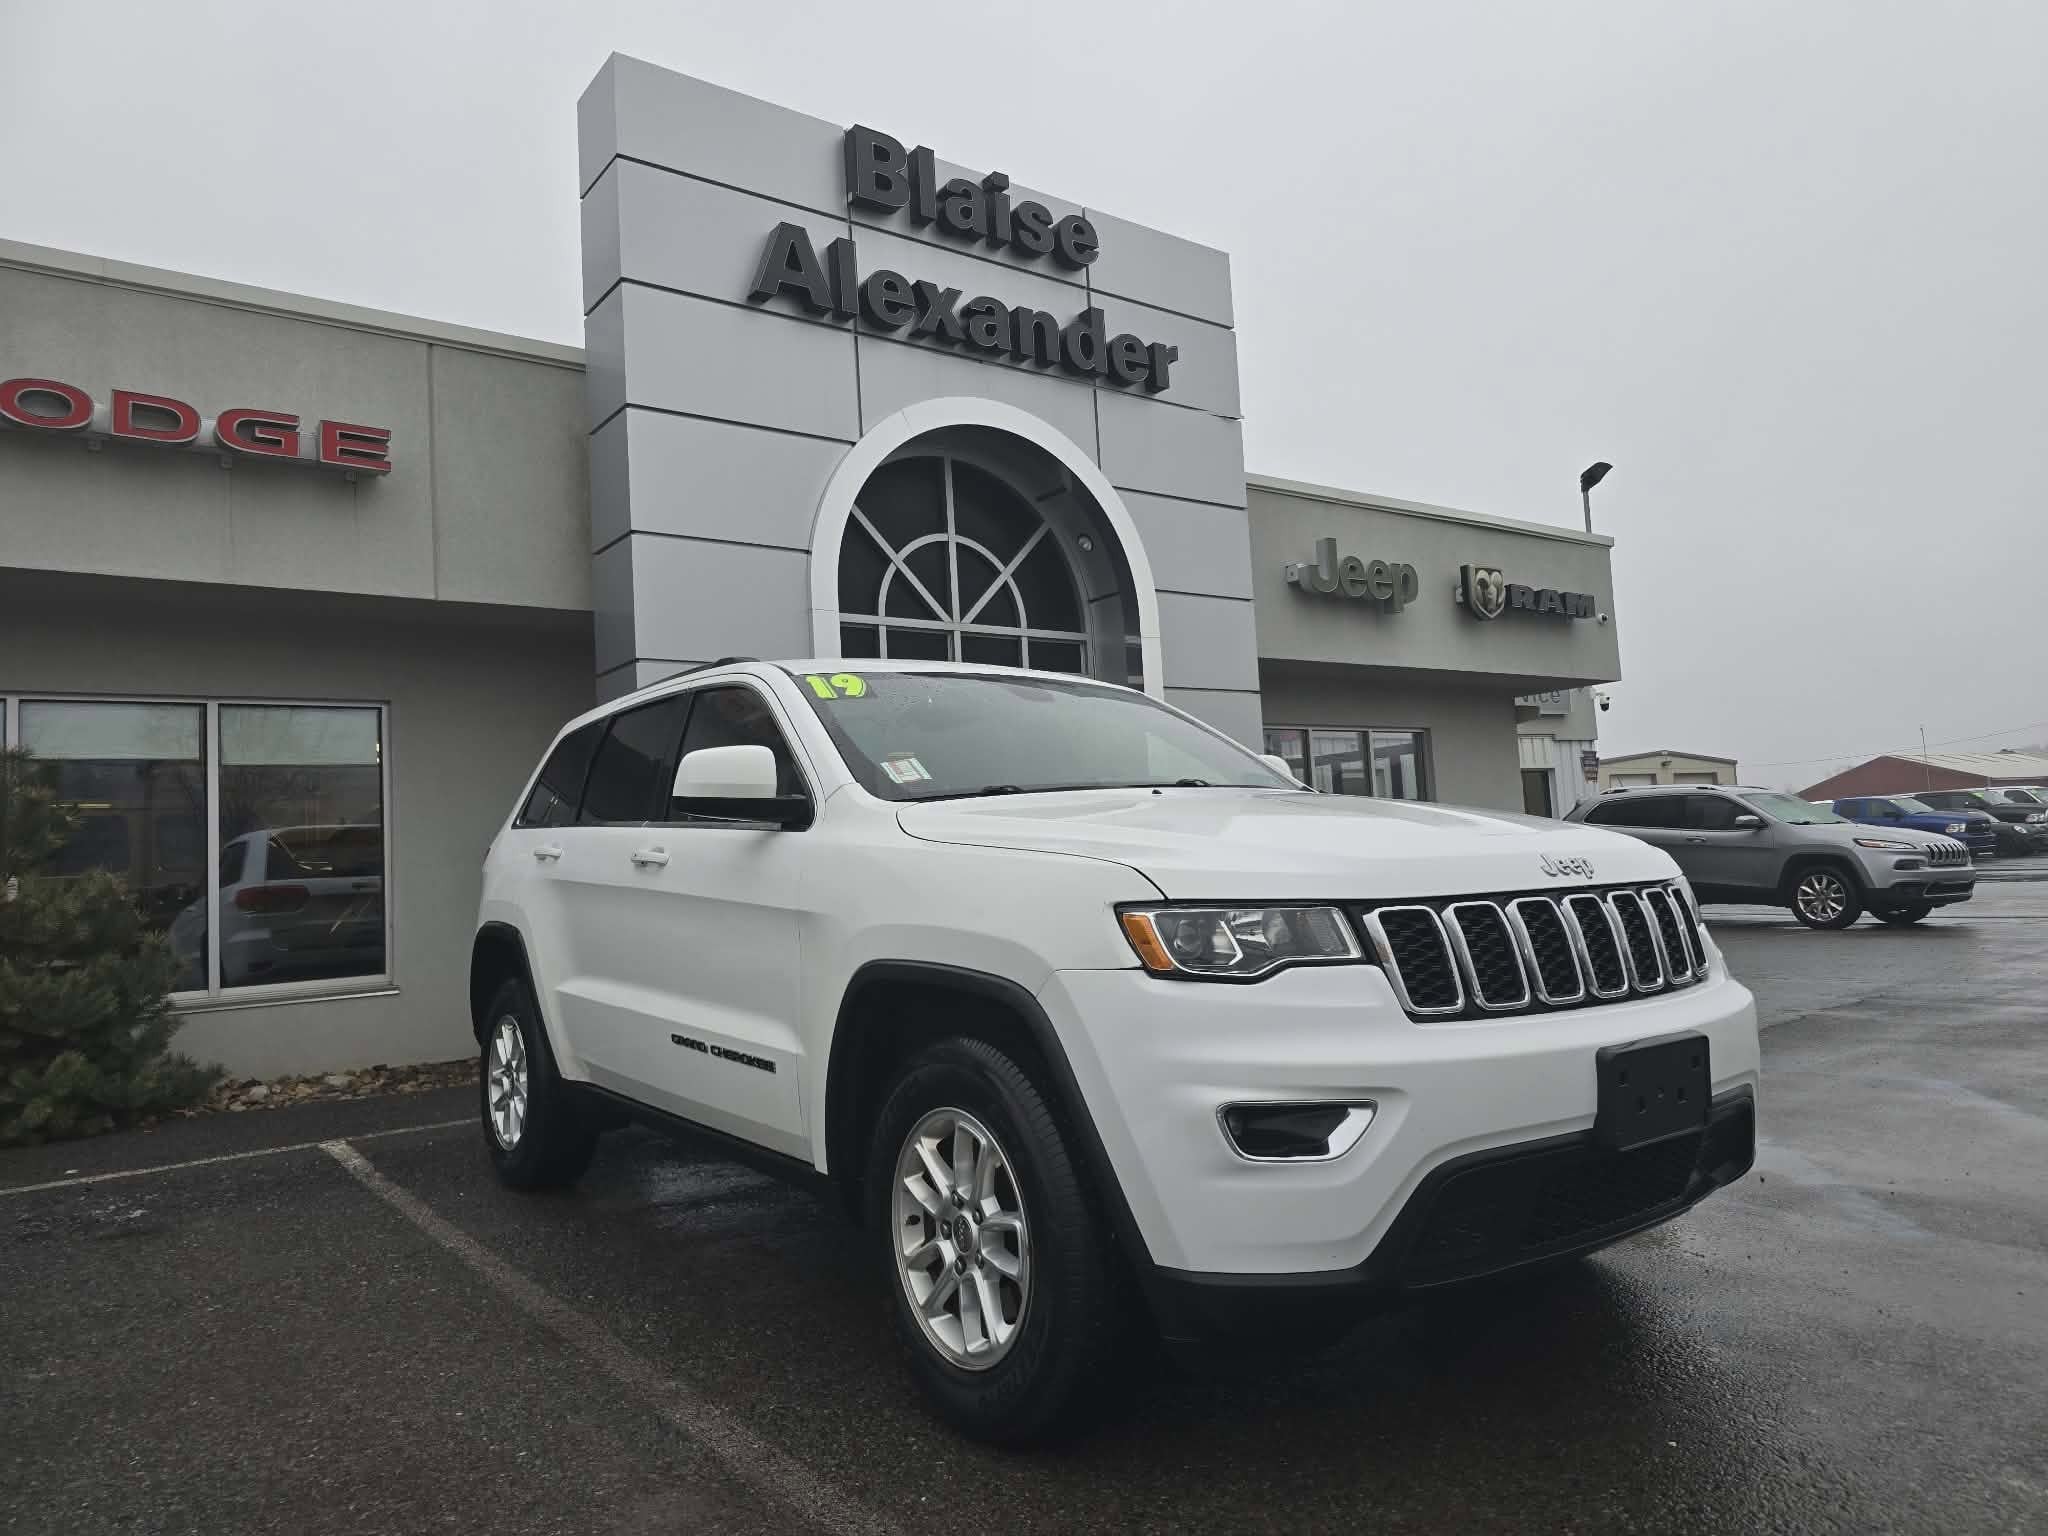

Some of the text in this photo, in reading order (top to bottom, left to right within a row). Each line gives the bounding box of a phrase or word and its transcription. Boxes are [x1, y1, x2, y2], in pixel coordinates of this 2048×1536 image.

[845, 123, 1099, 271] Blaise
[748, 220, 1178, 393] Alexander
[1301, 537, 1419, 614] Jeep
[1505, 583, 1596, 619] RAM
[806, 673, 867, 700] 19
[1539, 853, 1594, 880] Jeep
